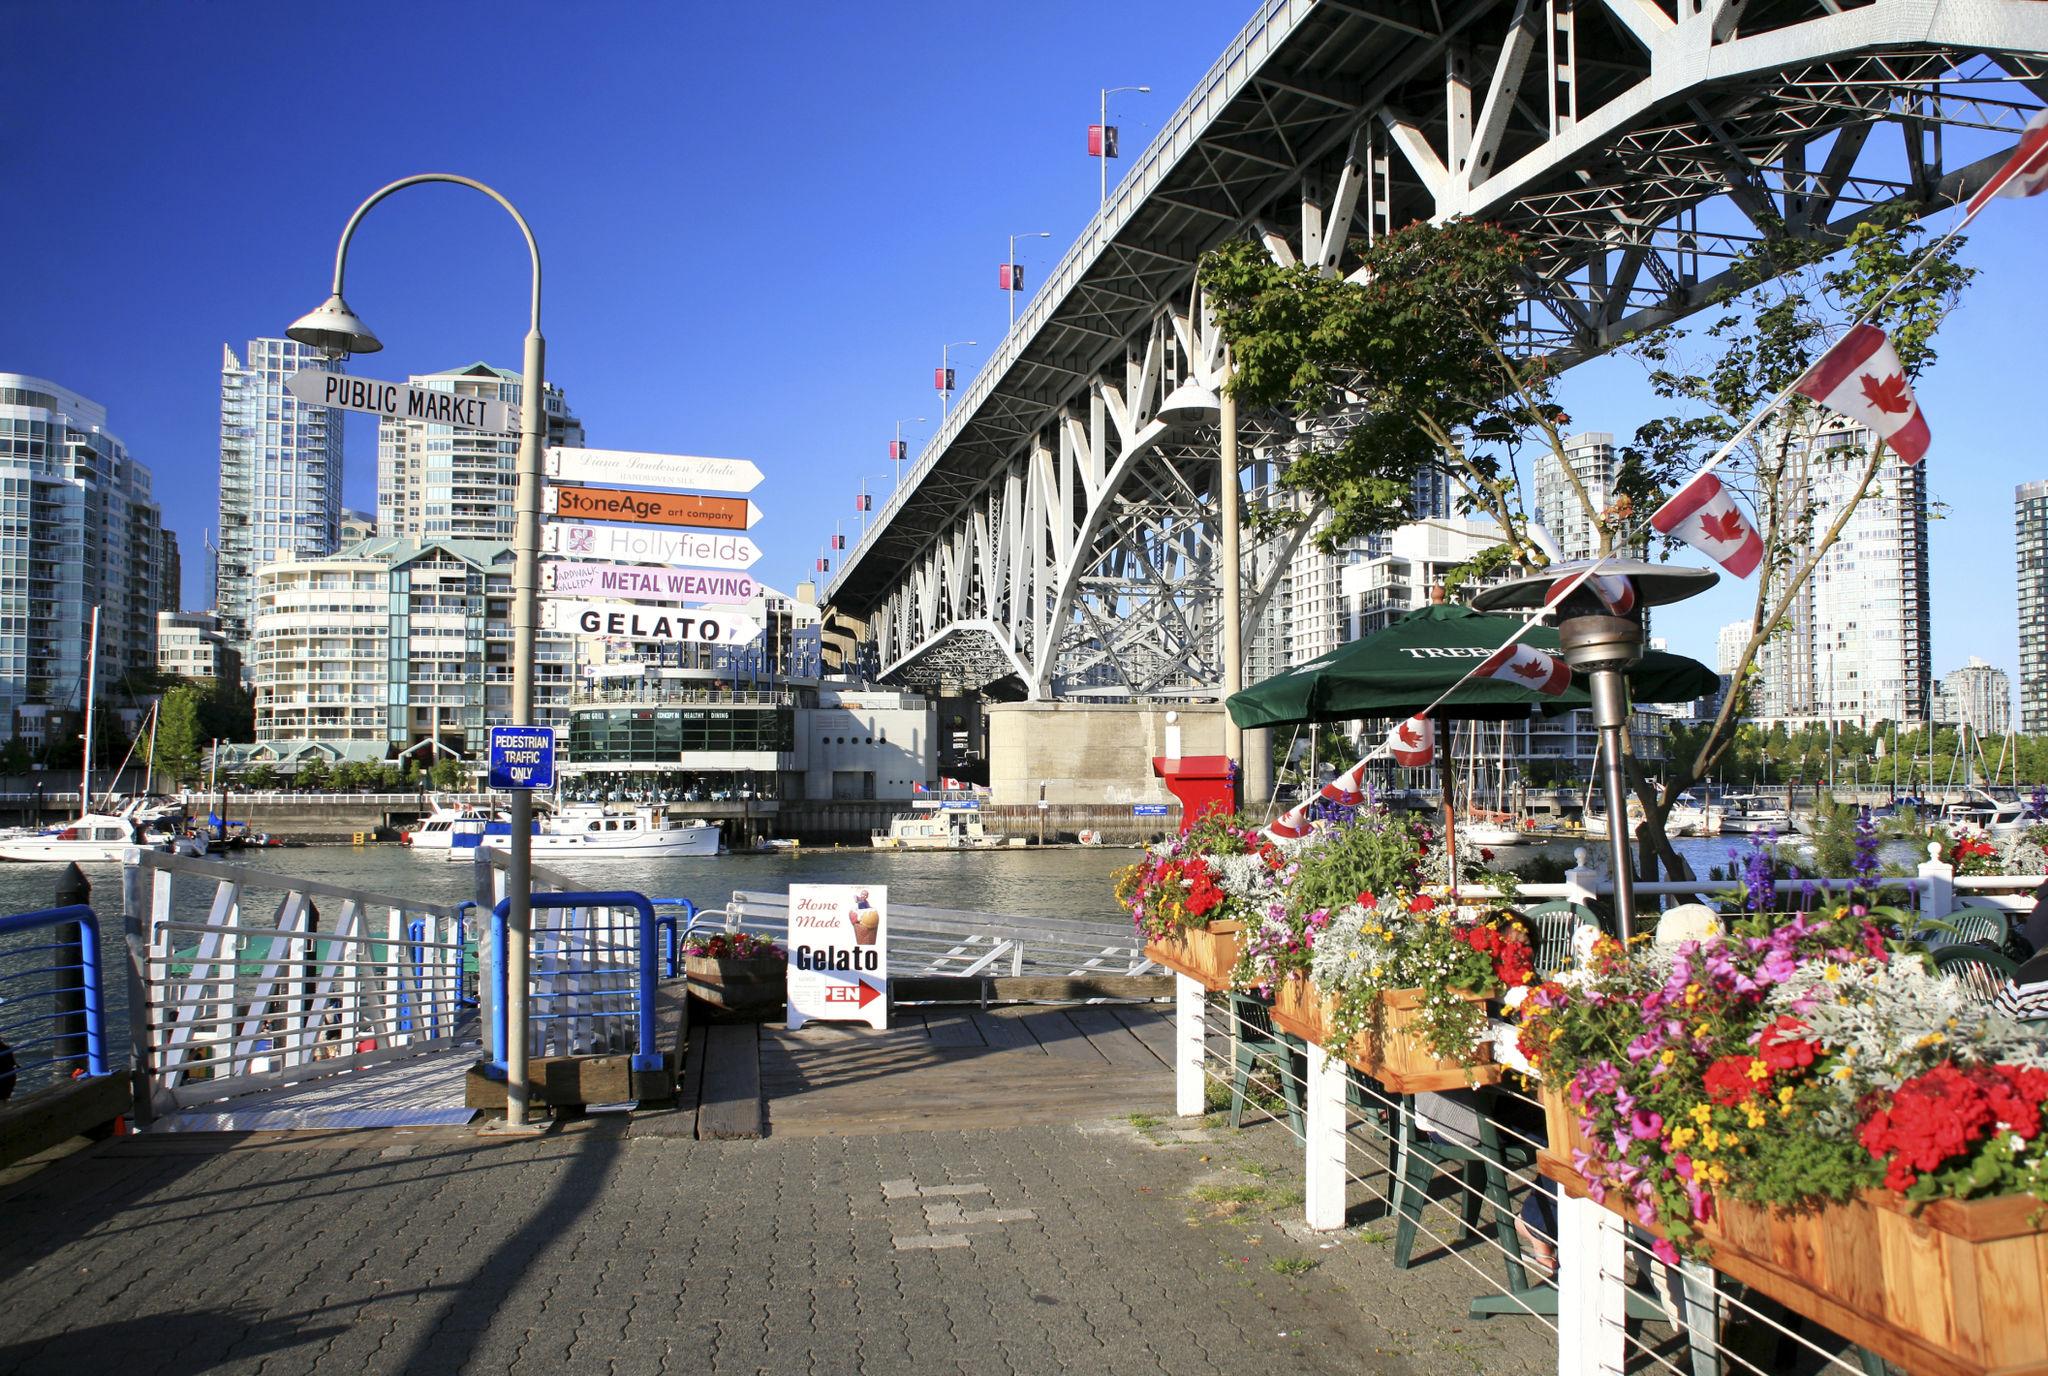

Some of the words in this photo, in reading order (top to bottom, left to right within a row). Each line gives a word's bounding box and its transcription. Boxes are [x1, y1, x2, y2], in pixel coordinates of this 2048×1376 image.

[326, 376, 397, 413] PUBLIC
[408, 390, 487, 427] MARKET
[580, 453, 620, 468] Diana
[626, 455, 691, 473] Sanderson
[696, 461, 736, 476] Studio
[560, 491, 662, 519] StoneAge
[668, 508, 683, 517] art
[687, 510, 734, 522] company
[611, 530, 750, 562] Hollyfields
[601, 571, 661, 593] METAL
[667, 575, 751, 597] WEAVING
[580, 611, 720, 641] GELATO
[495, 735, 549, 749] PEDESTRIAN
[504, 750, 540, 764] TRAFFIC
[510, 767, 533, 780] ONLY
[797, 898, 838, 911] Home
[795, 916, 841, 929] Made
[797, 945, 878, 971] Gelato
